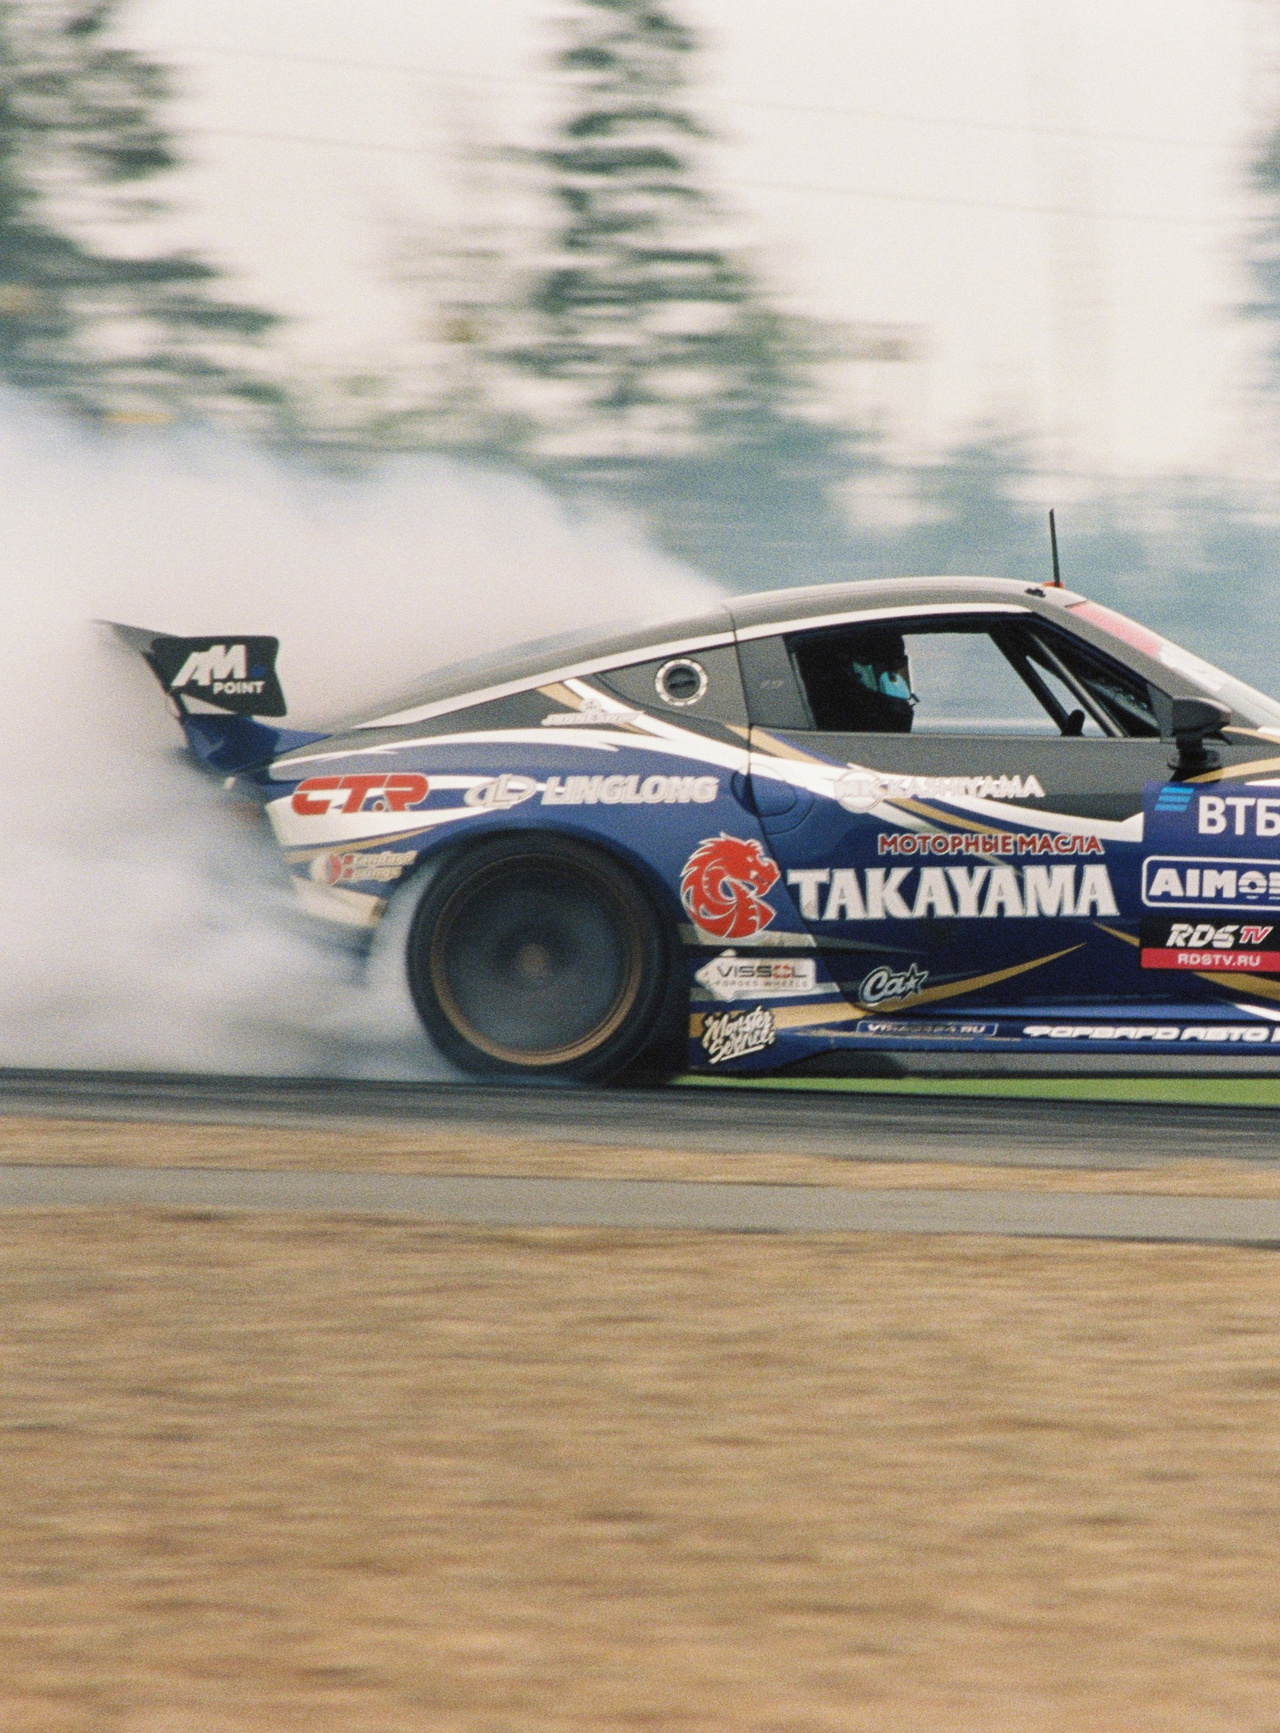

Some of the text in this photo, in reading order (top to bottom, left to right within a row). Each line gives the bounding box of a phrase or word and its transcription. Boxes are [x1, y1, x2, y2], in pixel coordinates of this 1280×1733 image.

[213, 680, 265, 695] POINT
[292, 773, 429, 816] CTR
[541, 775, 720, 805] LINGLONG
[886, 774, 1046, 799] KASHIYAMA
[878, 833, 1105, 855] МОТОРНЫЕ МАСЛА
[787, 863, 1121, 921] TAKAYAMA
[1166, 923, 1273, 948] RDS TV
[716, 964, 807, 978] VISSOL
[1177, 953, 1261, 968] RDSTV.RU
[1023, 1026, 1270, 1042] ФОРВАРД АВТО
